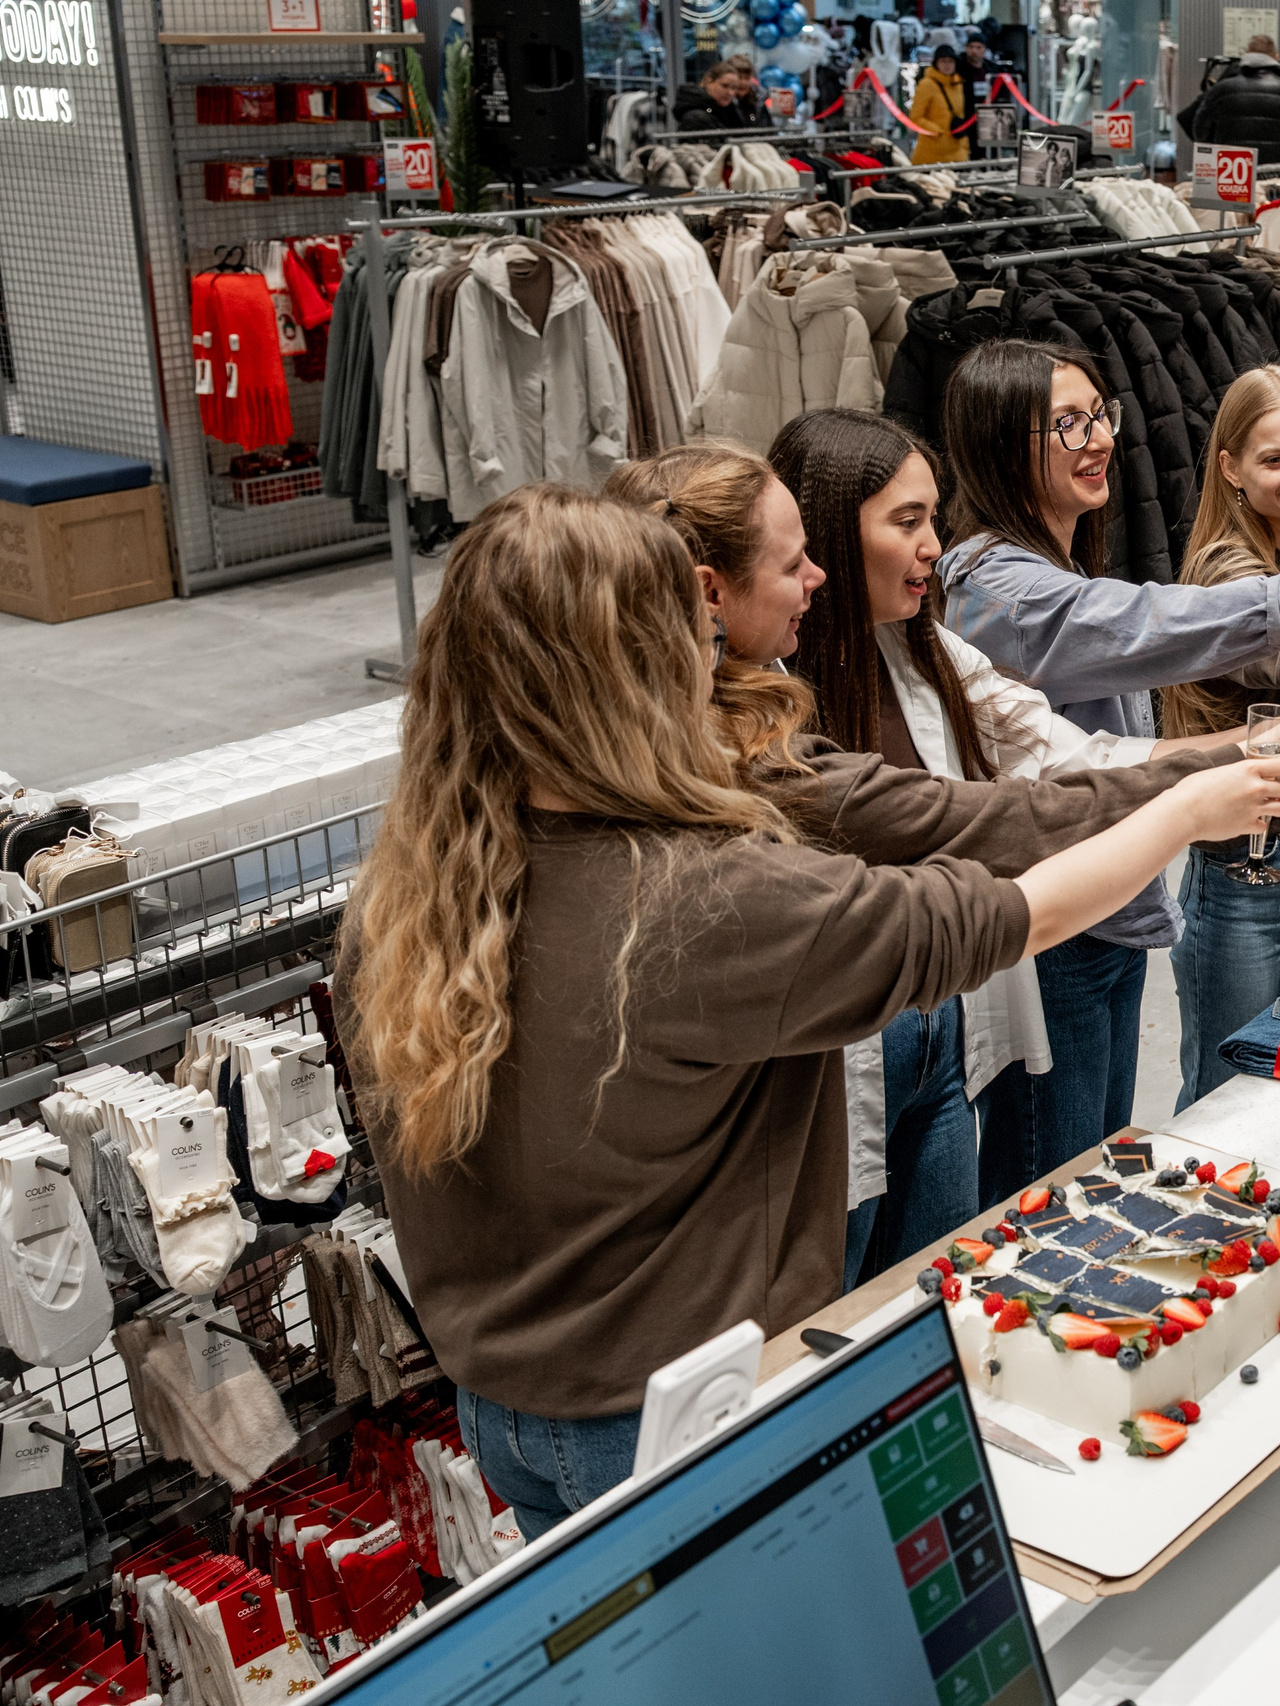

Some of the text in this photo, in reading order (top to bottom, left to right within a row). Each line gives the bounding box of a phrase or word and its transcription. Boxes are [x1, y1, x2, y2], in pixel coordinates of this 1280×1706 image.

[0, 0, 98, 66] ODAY!
[291, 1072, 316, 1087] COLIN'S
[171, 1142, 203, 1156] COLIN'S
[25, 1183, 56, 1198] COLIN'S
[201, 1339, 232, 1357] COLIN'S
[15, 1444, 50, 1458] COLIN'S
